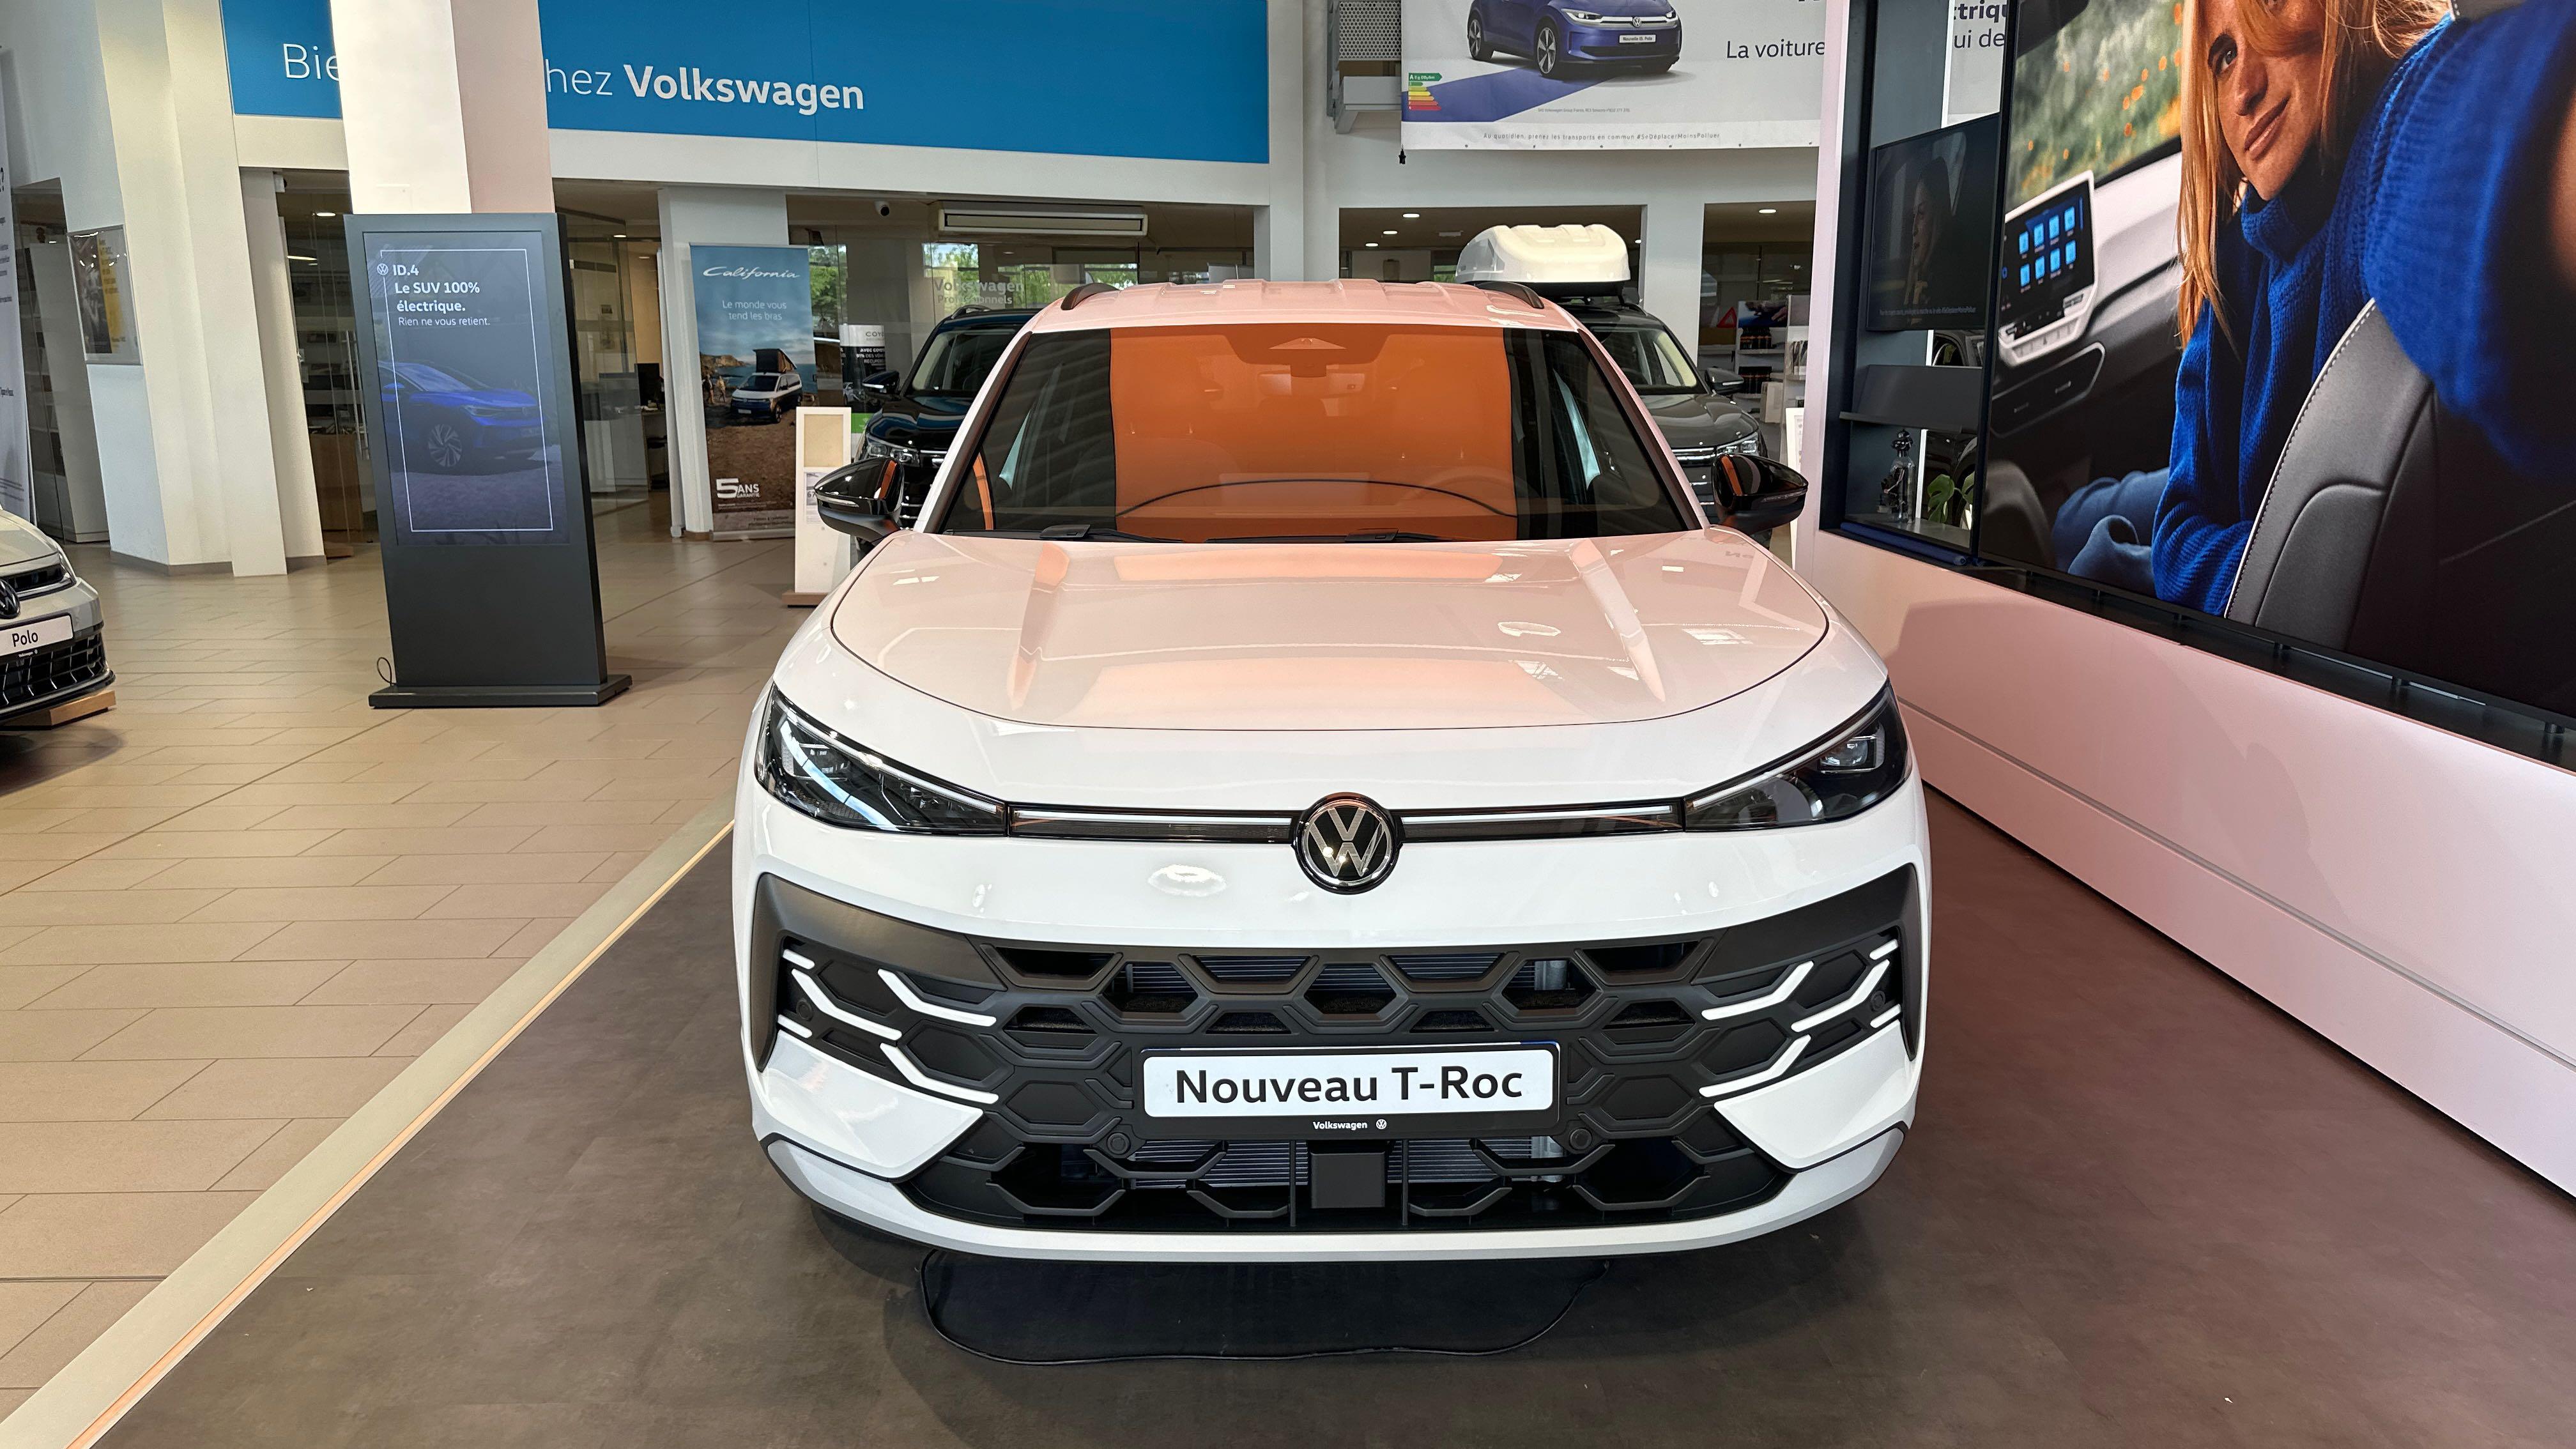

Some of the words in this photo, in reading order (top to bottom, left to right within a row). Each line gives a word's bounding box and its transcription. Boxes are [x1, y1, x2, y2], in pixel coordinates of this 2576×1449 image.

[1954, 29, 1972, 48] ui
[1979, 28, 2005, 47] de
[1727, 41, 1749, 58] La
[1755, 39, 1825, 57] voiture
[623, 64, 864, 116] Volkswagen
[392, 264, 419, 276] ID.4
[703, 266, 801, 279] California
[394, 282, 410, 294] Le
[413, 282, 441, 294] SUV
[443, 282, 480, 294] 100%
[934, 279, 1024, 295] Volkswagen
[397, 300, 466, 314] électrique.
[722, 300, 733, 309] Le
[735, 300, 765, 309] monde
[398, 317, 418, 326] Rien
[459, 317, 491, 326] retient.
[729, 312, 748, 320] tend
[750, 312, 763, 320] les
[764, 312, 783, 320] bras
[716, 478, 739, 499] 5
[737, 484, 760, 493] ANS
[12, 629, 38, 647] Polo
[1176, 1069, 1377, 1103] Nouveau
[1392, 1065, 1523, 1100] T-Roc
[1312, 1121, 1368, 1131] Volkswagen
